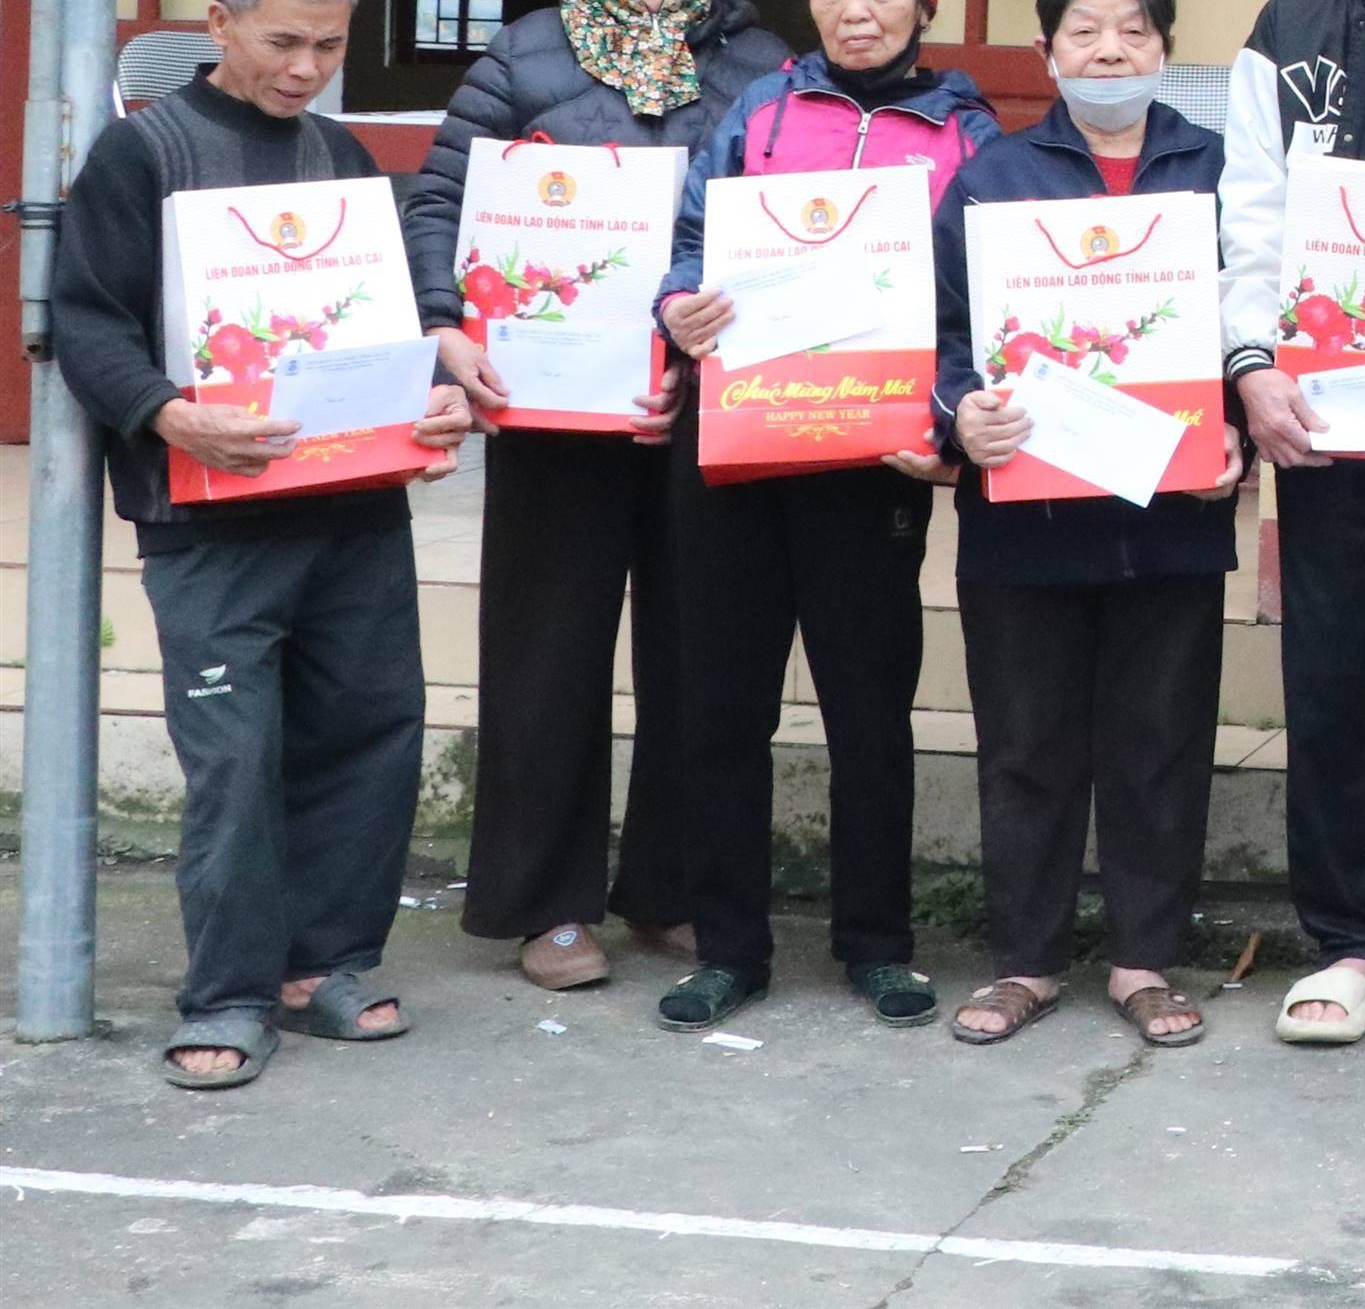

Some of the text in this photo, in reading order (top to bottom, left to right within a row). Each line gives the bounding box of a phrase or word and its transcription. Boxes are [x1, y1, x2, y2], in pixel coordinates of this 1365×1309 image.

[720, 375, 916, 411] Chúc Mừng Năm Mới
[766, 409, 871, 421] HAPPY NEW YEAR
